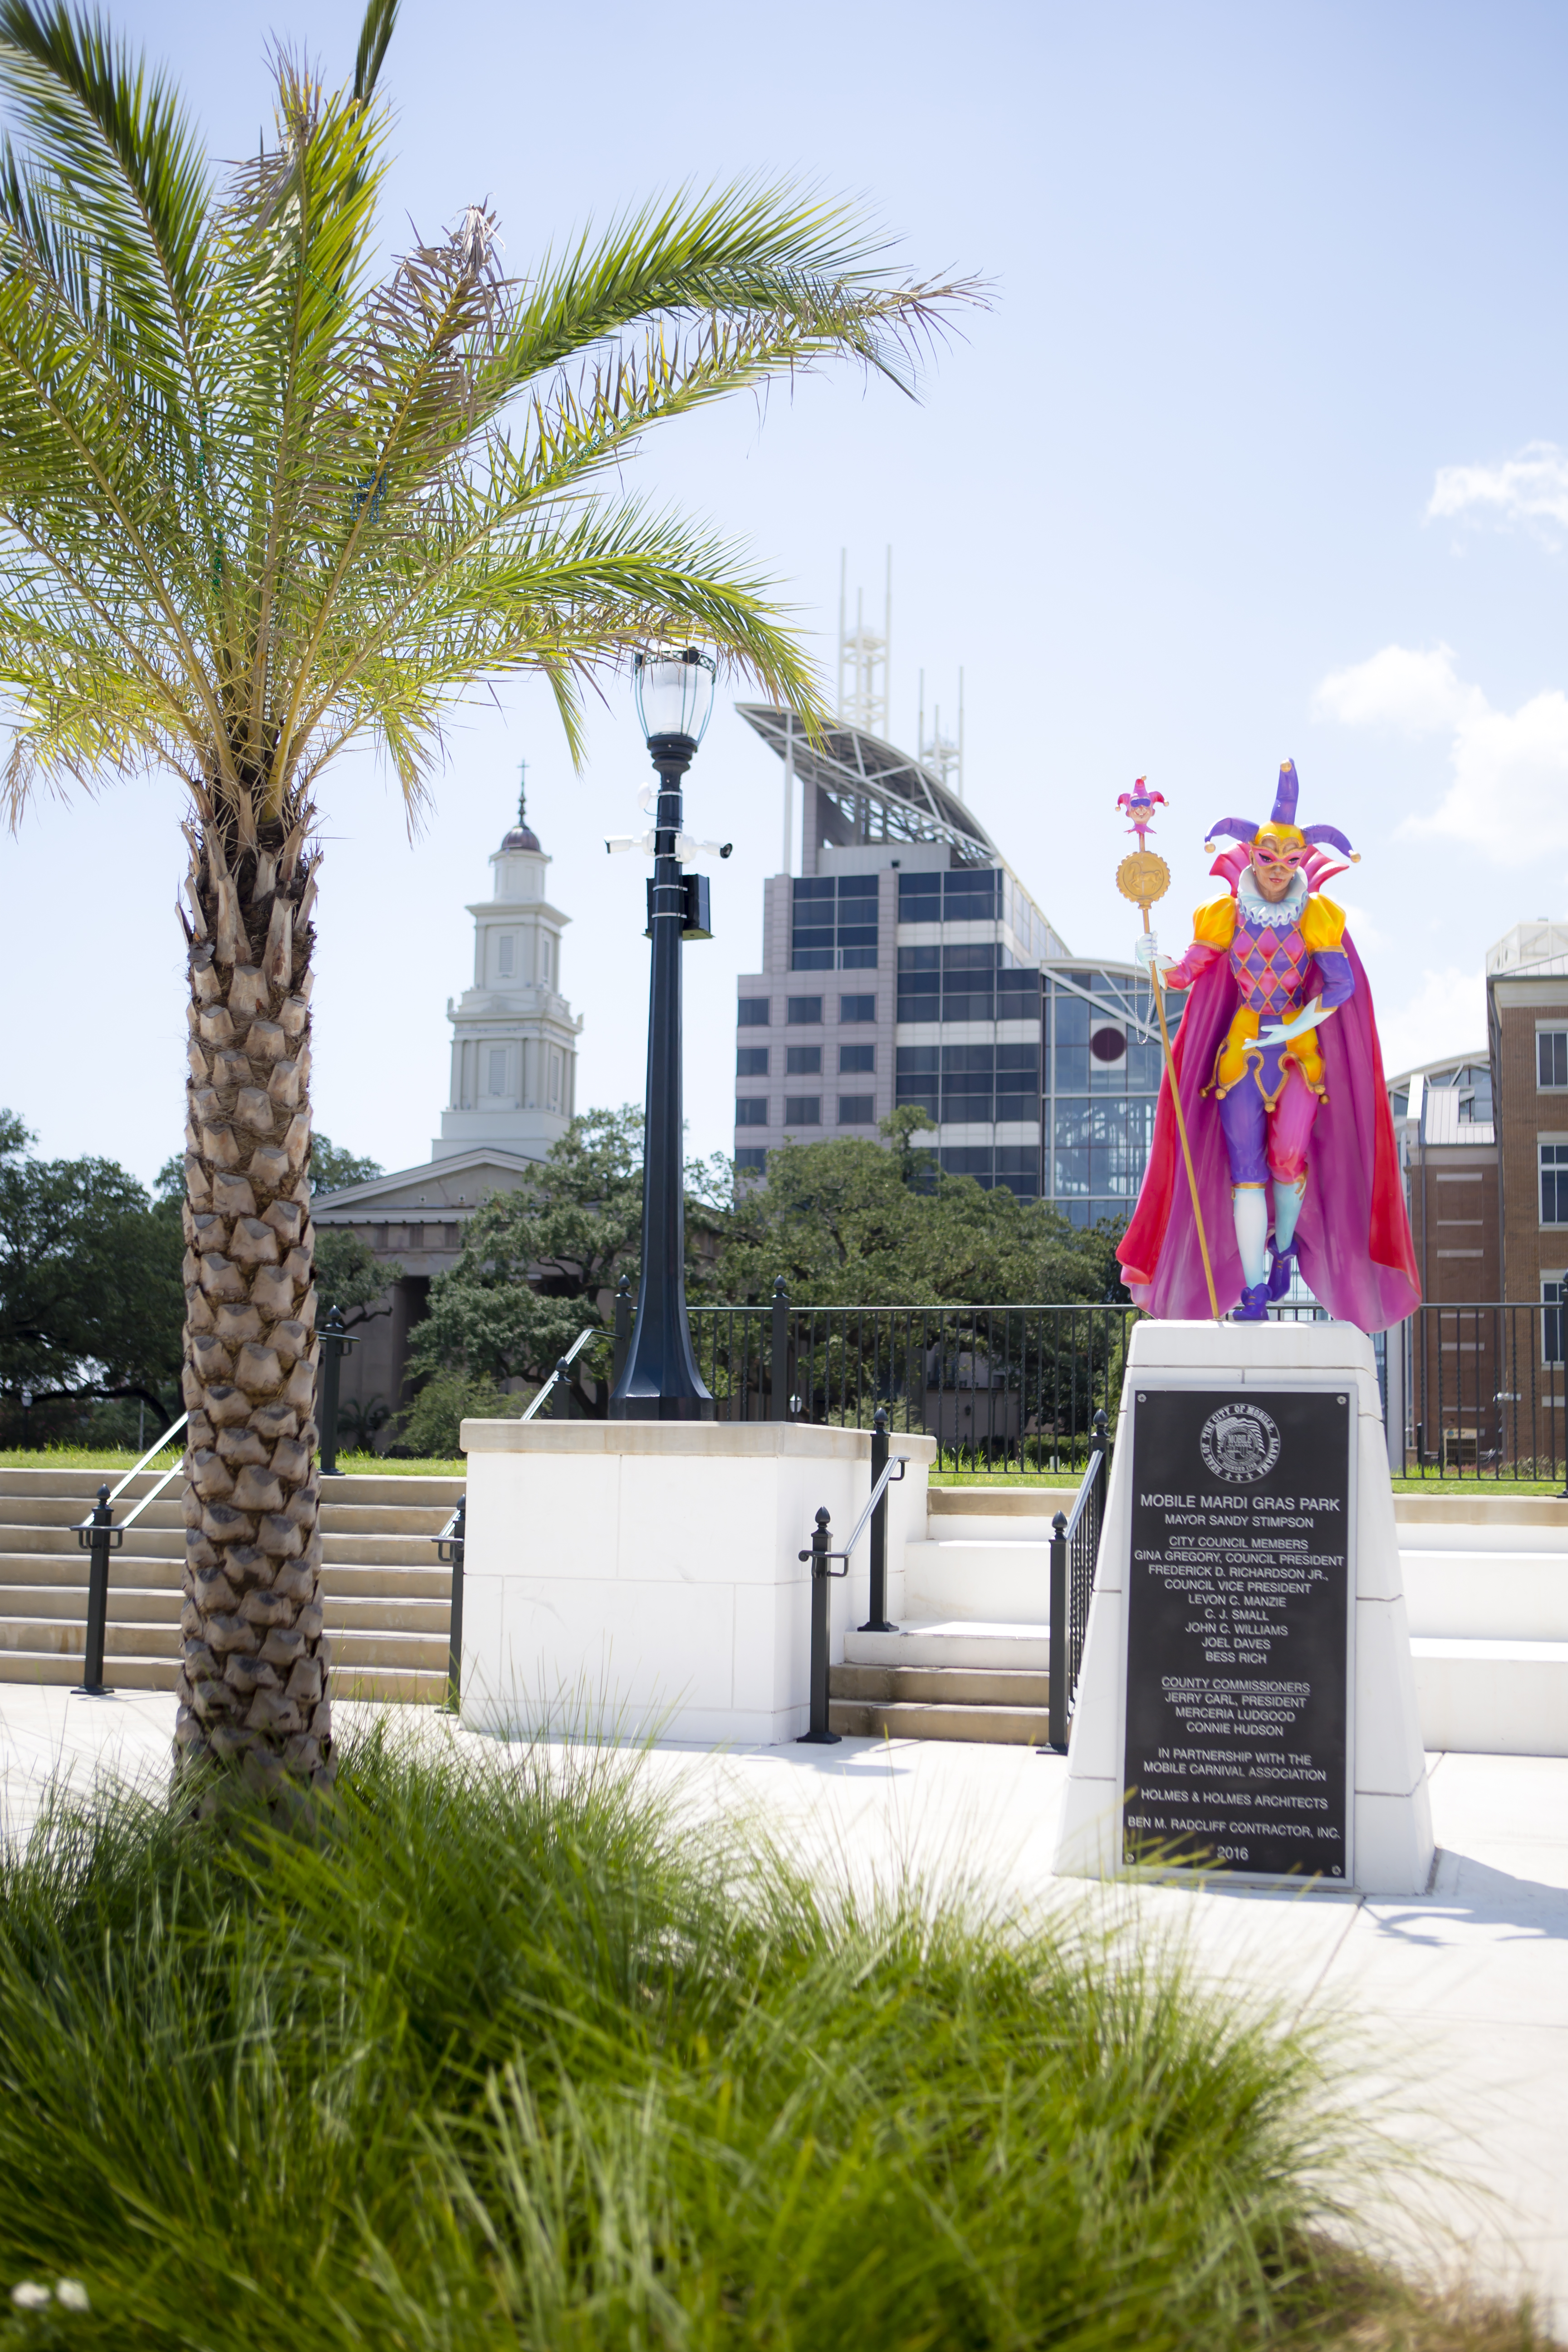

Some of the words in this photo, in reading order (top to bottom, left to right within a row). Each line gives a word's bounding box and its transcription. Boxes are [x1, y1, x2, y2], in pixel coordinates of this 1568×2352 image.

[1211, 1407, 1231, 1423] CITY
[1234, 1405, 1245, 1413] OF
[1246, 1406, 1275, 1433] MOBILE,
[1202, 1421, 1215, 1439] THE
[1227, 1434, 1252, 1444] MOBILE
[1202, 1442, 1210, 1454] OF
[1255, 1437, 1279, 1475] ALABAMA
[1205, 1454, 1223, 1475] SEAL
[1140, 1494, 1196, 1508] MOBILE
[1200, 1495, 1248, 1509] MARDI
[1252, 1496, 1295, 1511] GRAS
[1299, 1497, 1341, 1512] PARK
[1165, 1514, 1206, 1525] MAYOR
[1208, 1514, 1250, 1527] SANDY
[1251, 1515, 1314, 1529] STIMPSON
[1169, 1535, 1196, 1547] CITY
[1197, 1536, 1249, 1548] COUNCIL
[1251, 1538, 1309, 1550] MEMBERS
[1134, 1549, 1162, 1561] GINA
[1164, 1550, 1222, 1564] GREGORY,
[1225, 1552, 1277, 1564] COUNCIL
[1279, 1554, 1345, 1566] PRESIDENT
[1148, 1564, 1213, 1577] FREDERICK
[1215, 1566, 1226, 1577] D.
[1229, 1566, 1305, 1579] RICHARDSON
[1307, 1569, 1329, 1581] JR.,
[1164, 1578, 1215, 1591] COUNCIL
[1217, 1580, 1245, 1592] VICE
[1247, 1581, 1312, 1594] PRESIDENT
[1188, 1593, 1226, 1606] LEVON
[1229, 1595, 1241, 1606] C.
[1243, 1595, 1287, 1607] MANZIE
[1204, 1608, 1216, 1619] C.
[1218, 1608, 1228, 1620] J.
[1231, 1609, 1270, 1621] SMALL
[1185, 1622, 1217, 1634] JOHN
[1219, 1622, 1231, 1634] C.
[1234, 1623, 1289, 1636] WILLIAMS
[1201, 1637, 1231, 1648] JOEL
[1233, 1637, 1271, 1650] DAVES
[1205, 1651, 1236, 1663] BESS
[1239, 1652, 1267, 1664] RICH
[1161, 1676, 1210, 1689] COUNTY
[1212, 1678, 1311, 1694] COMMISSIONERS
[1164, 1691, 1202, 1704] JERRY
[1204, 1693, 1239, 1707] CARL,
[1241, 1695, 1307, 1708] PRESIDENT
[1175, 1706, 1235, 1720] MERCERIA
[1237, 1709, 1296, 1722] LUDGOOD
[1186, 1721, 1231, 1734] CONNIE
[1234, 1723, 1284, 1736] HUDSON
[1158, 1747, 1170, 1759] IN
[1173, 1748, 1253, 1763] PARTNERSHIP
[1254, 1752, 1285, 1764] WITH
[1287, 1754, 1312, 1766] THE
[1143, 1760, 1187, 1774] MOBILE
[1189, 1763, 1245, 1777] CARNIVAL
[1248, 1766, 1326, 1782] ASSOCIATION
[1141, 1788, 1189, 1802] HOLMES
[1191, 1791, 1200, 1803] &
[1203, 1792, 1252, 1806] HOLMES
[1254, 1794, 1328, 1809] ARCHITECTS
[1127, 1815, 1152, 1828] BEN
[1154, 1817, 1167, 1829] M.
[1171, 1818, 1227, 1832] RADCLIFF
[1229, 1822, 1313, 1838] CONTRACTOR,
[1317, 1827, 1341, 1839] INC.
[1216, 1845, 1249, 1861] 2016
